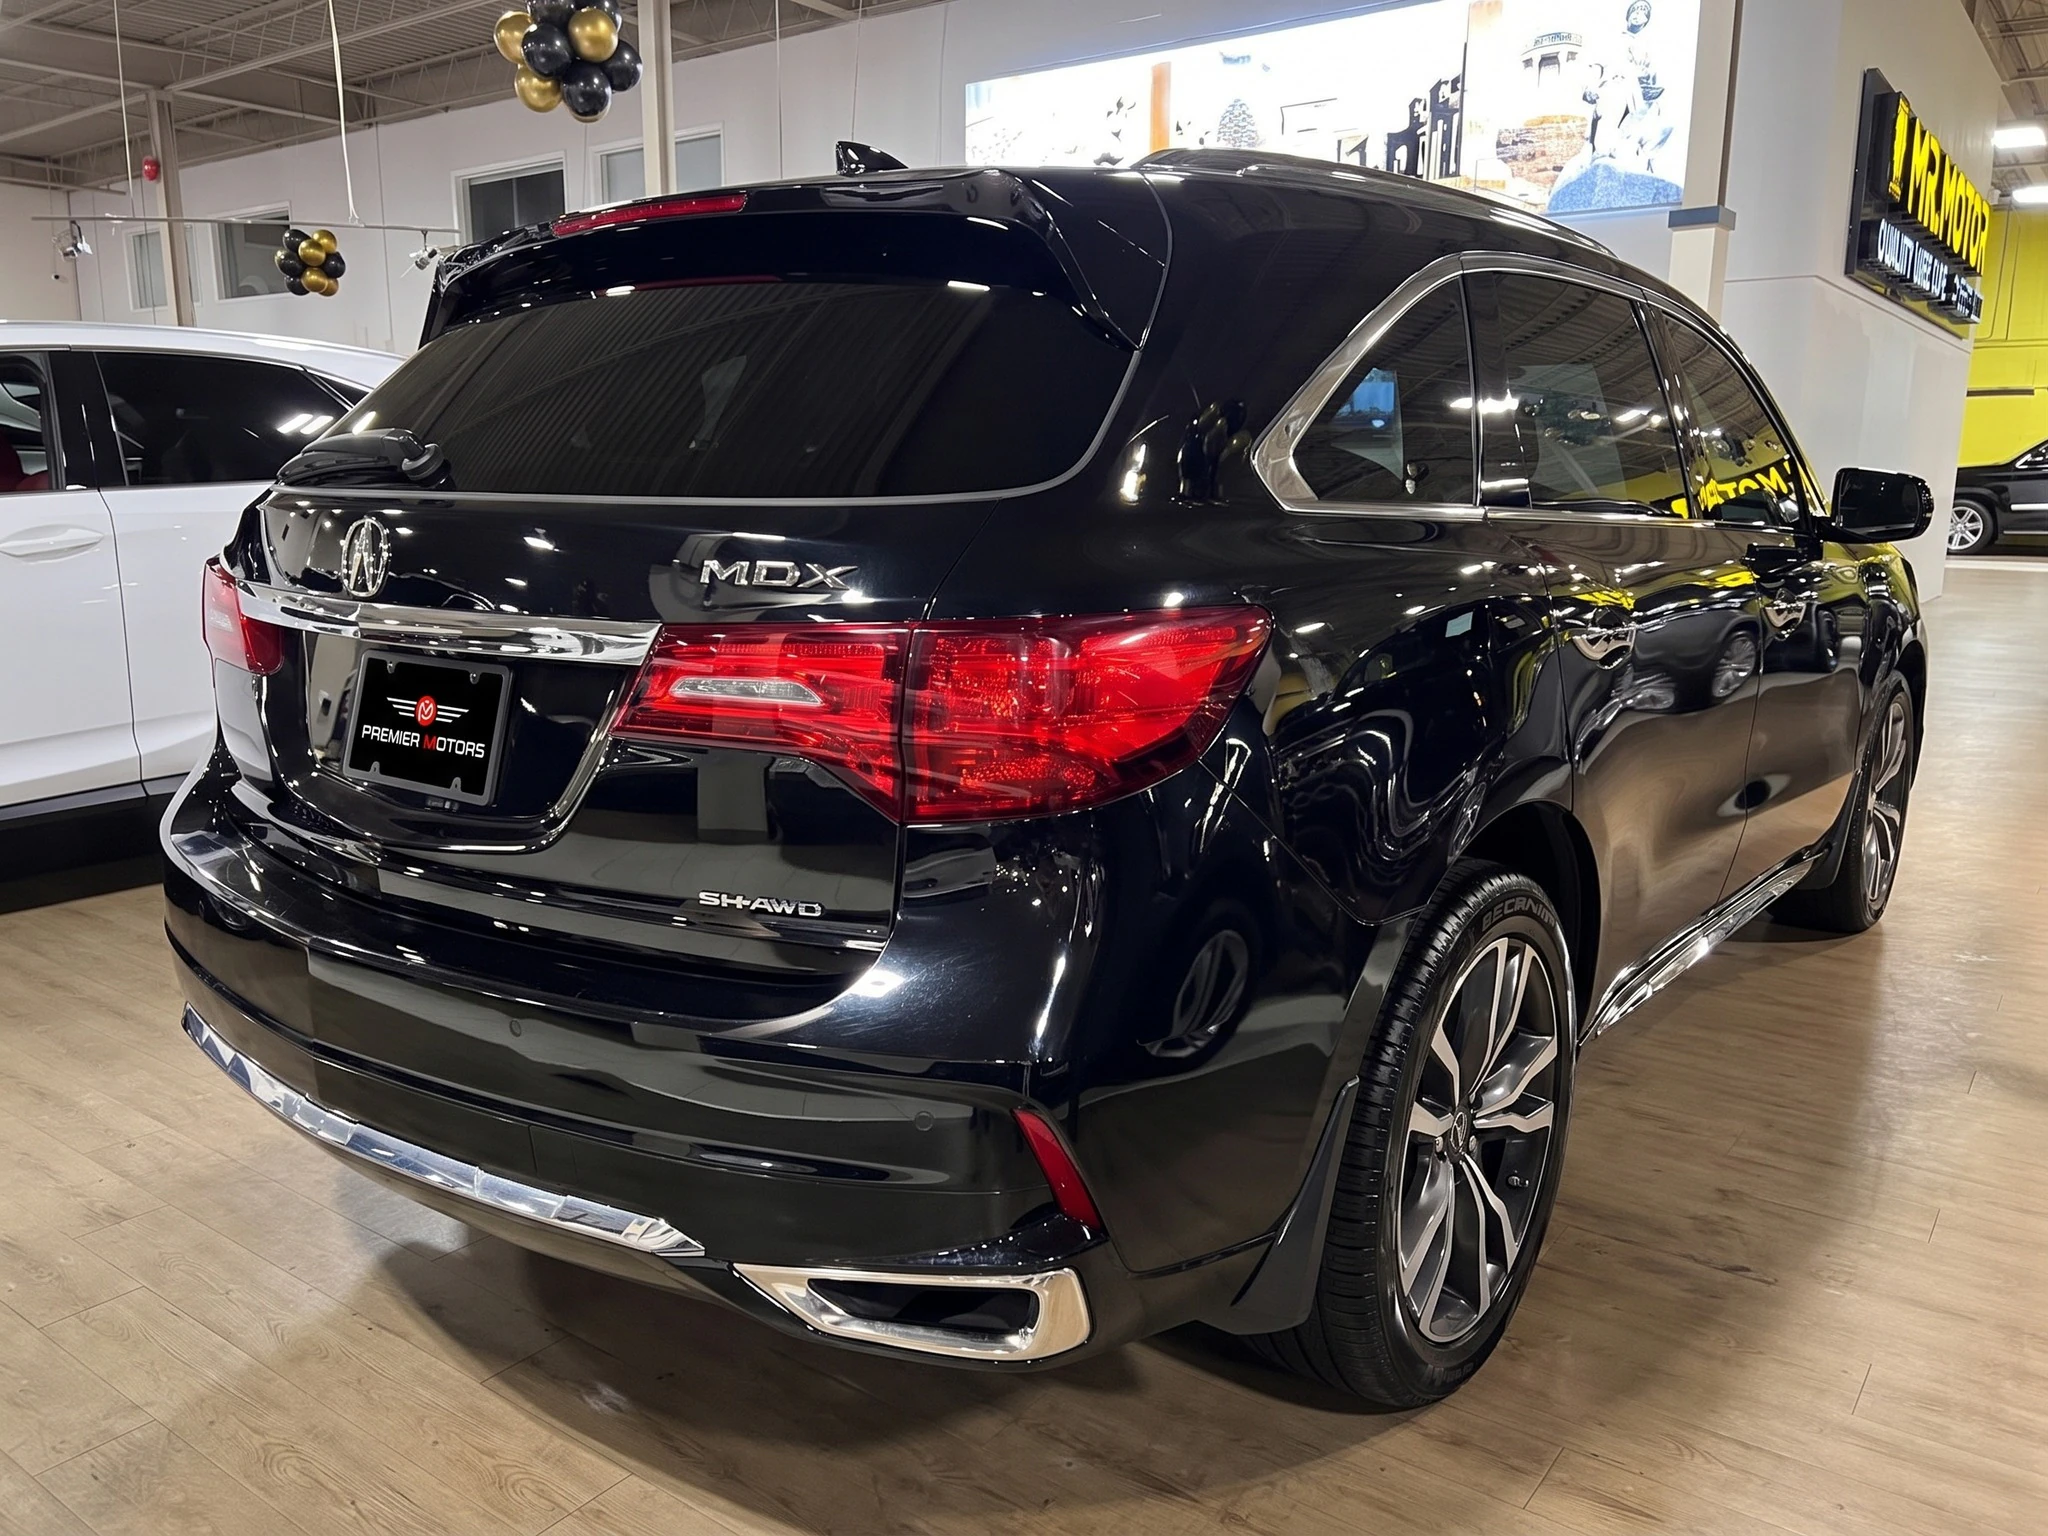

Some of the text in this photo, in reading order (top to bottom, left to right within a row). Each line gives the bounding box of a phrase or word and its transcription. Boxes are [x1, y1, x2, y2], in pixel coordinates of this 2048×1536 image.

[1907, 117, 1942, 236] MR.
[1939, 154, 1990, 276] MOTOR
[699, 559, 859, 591] MDX
[361, 724, 486, 758] PREMIER MOTORS
[698, 891, 822, 917] SH-AWD
